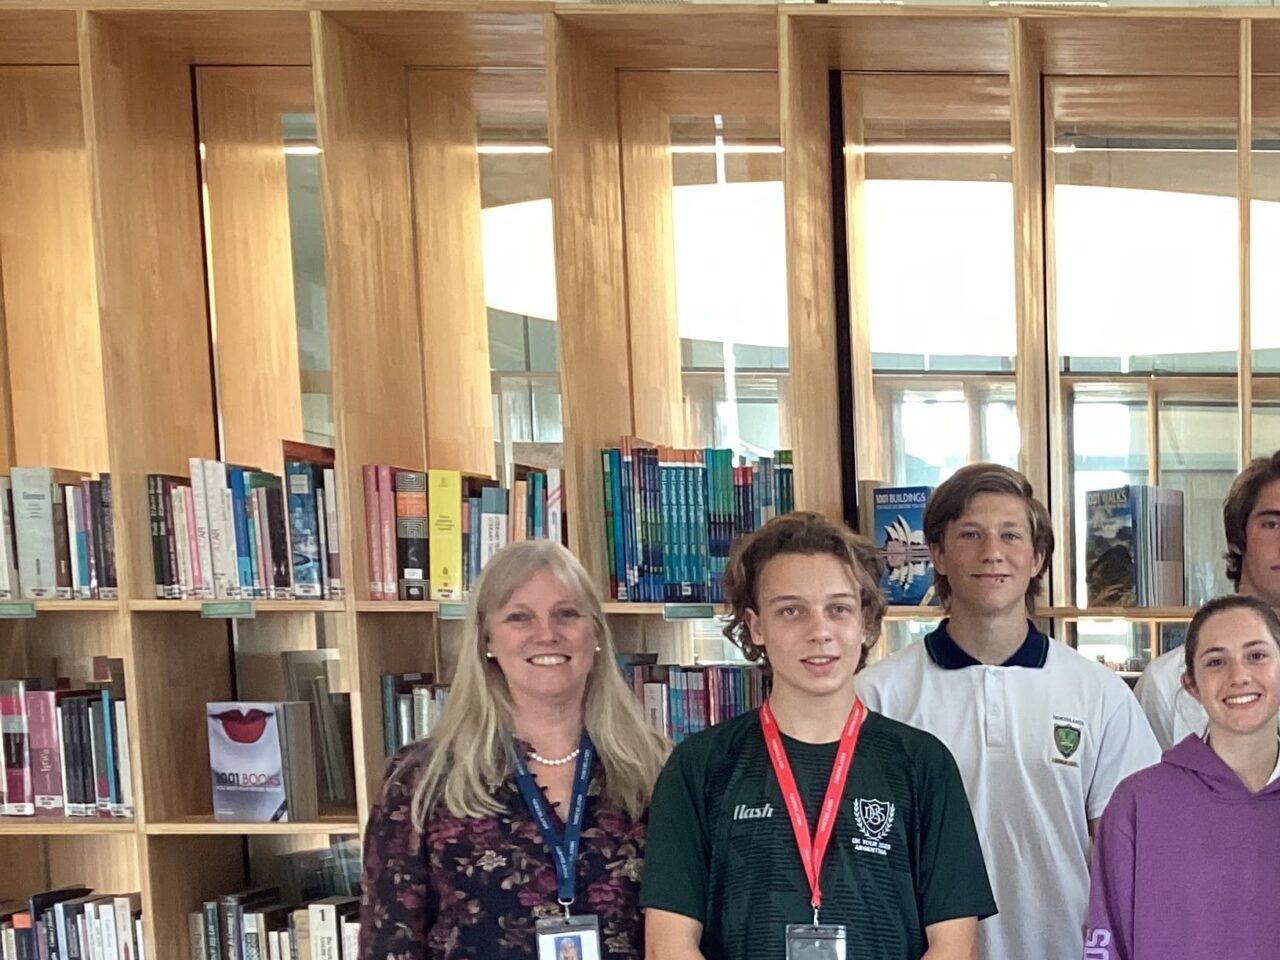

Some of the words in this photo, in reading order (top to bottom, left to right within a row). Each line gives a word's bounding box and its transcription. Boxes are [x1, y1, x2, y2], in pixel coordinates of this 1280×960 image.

[890, 492, 927, 504] BUILDINGS
[1102, 489, 1127, 506] WALKS
[216, 772, 239, 786] 1001
[242, 773, 281, 787] BOOKS
[851, 837, 861, 845] UK
[862, 838, 878, 848] TOUR
[854, 844, 888, 856] ARGENTINA
[319, 909, 326, 922] 1
